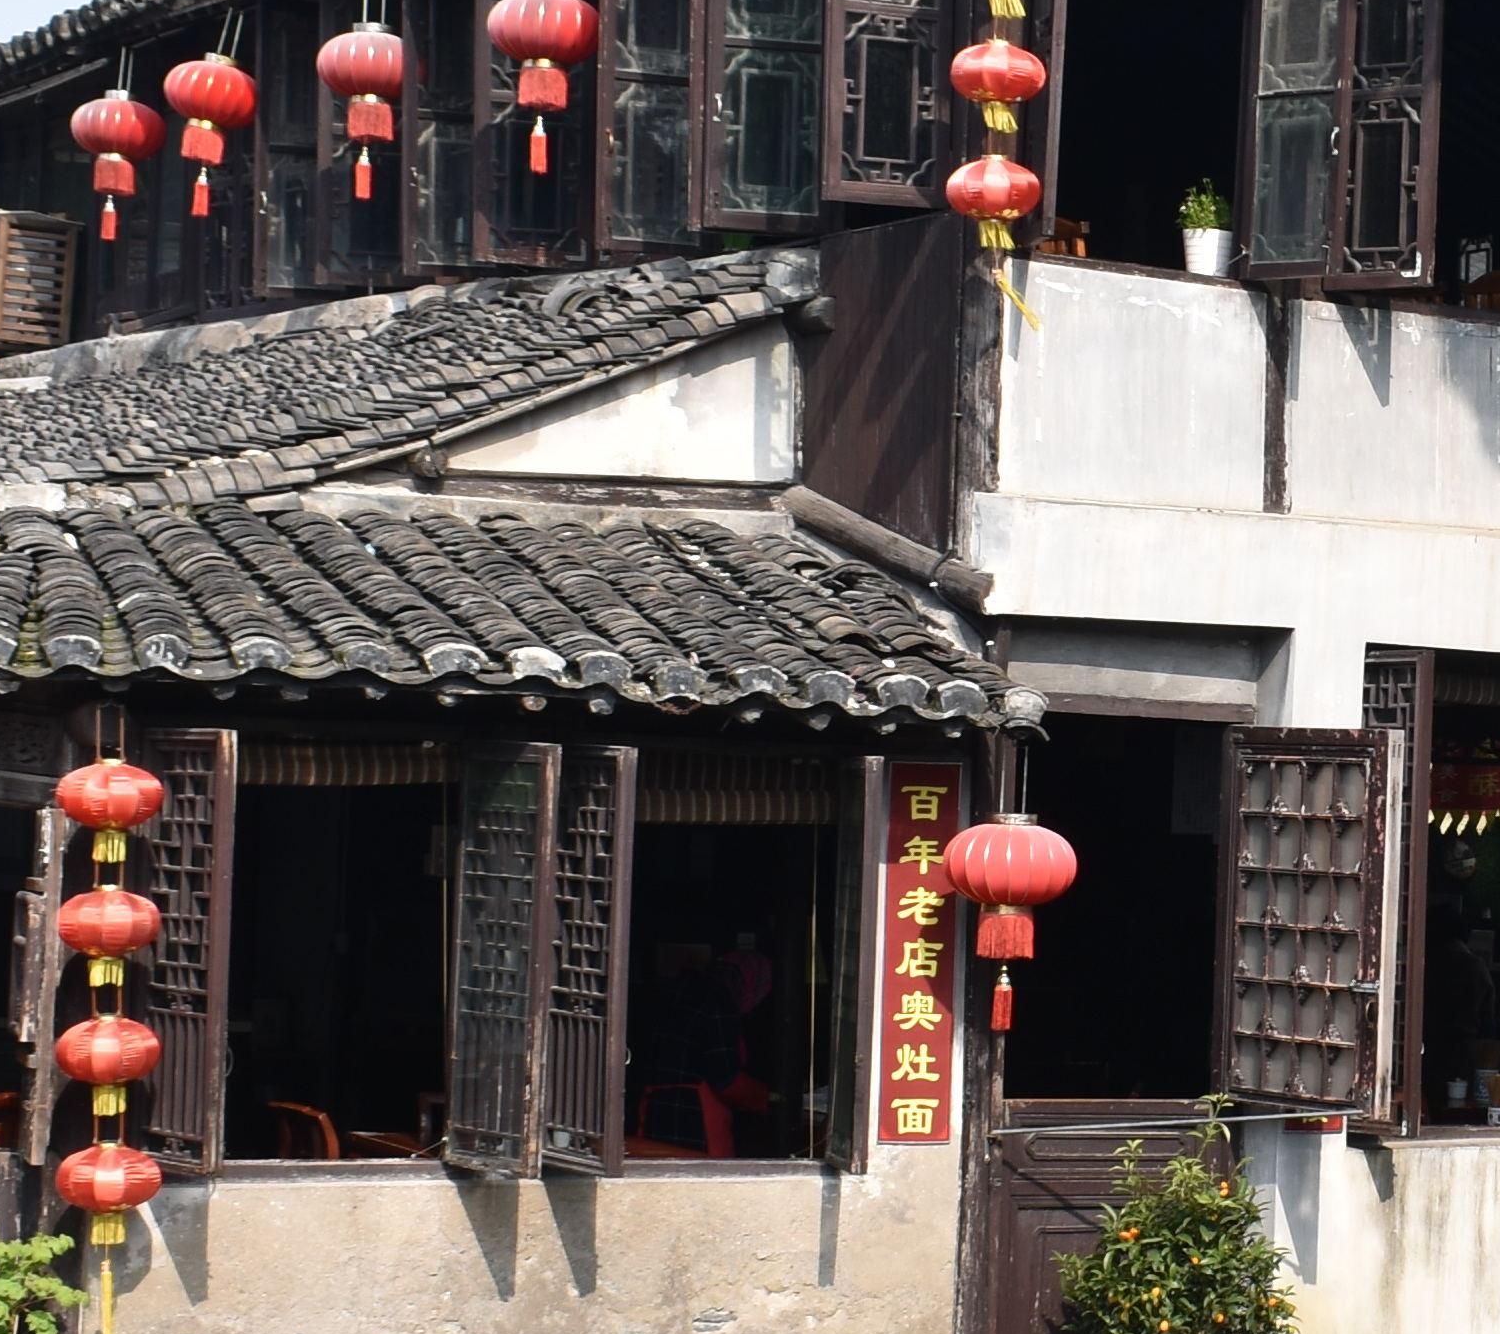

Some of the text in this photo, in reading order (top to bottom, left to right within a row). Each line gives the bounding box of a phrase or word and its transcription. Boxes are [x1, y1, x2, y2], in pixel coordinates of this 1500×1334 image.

[890, 785, 948, 1135] 百年老店奥灶面
